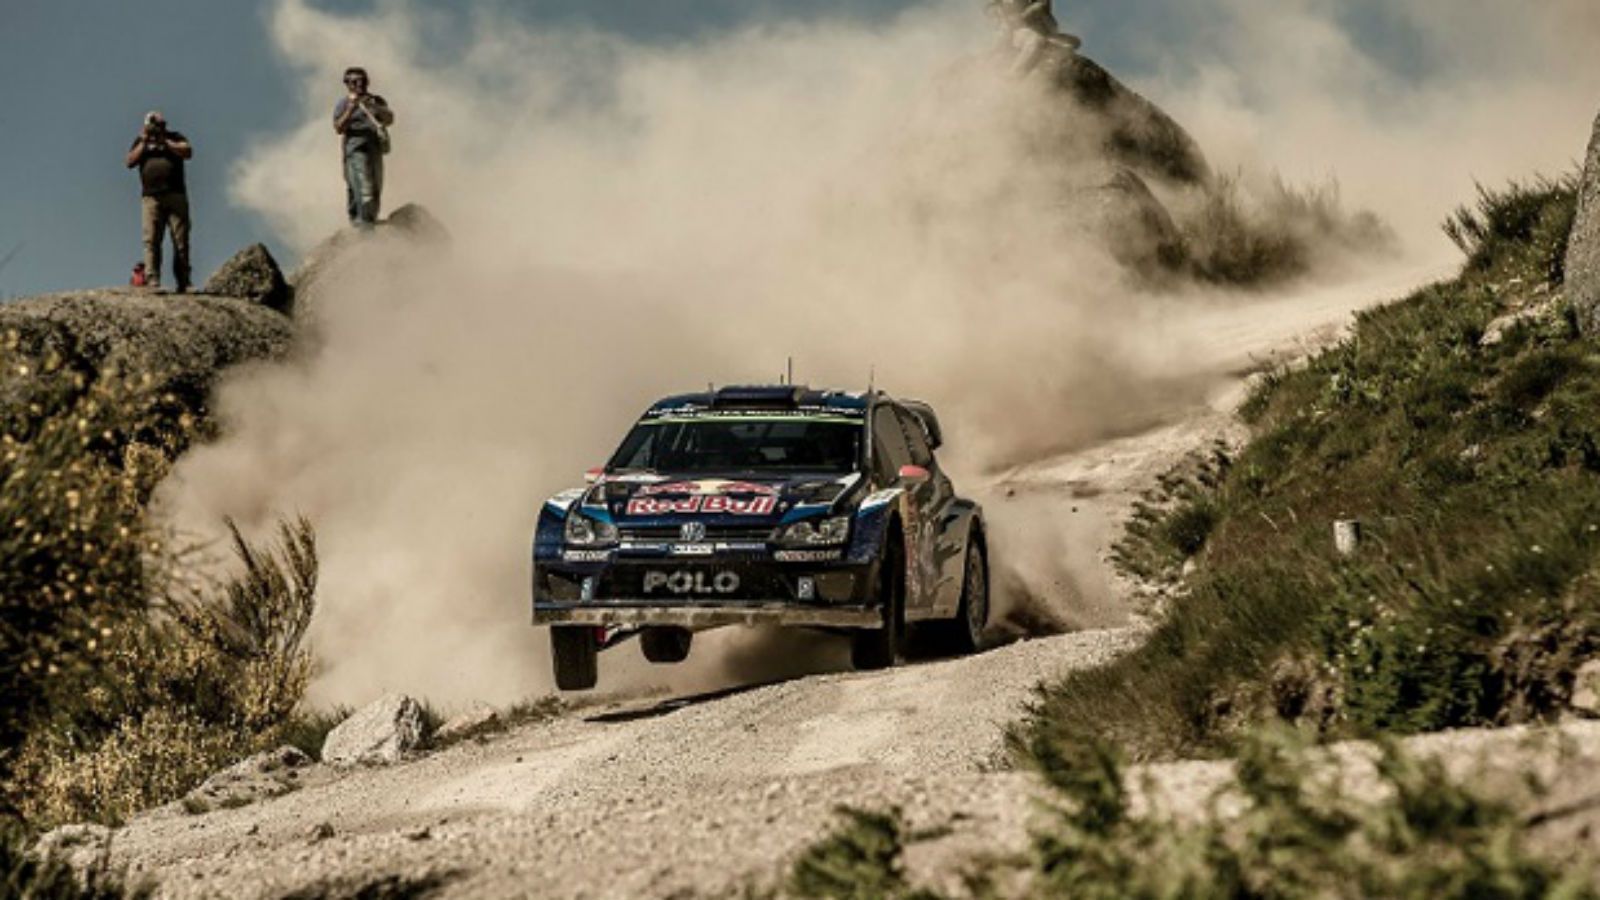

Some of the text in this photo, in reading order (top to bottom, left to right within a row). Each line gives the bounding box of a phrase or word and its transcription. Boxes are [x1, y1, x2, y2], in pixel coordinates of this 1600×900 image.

[626, 495, 778, 515] Red Bull
[643, 570, 740, 593] POLO
